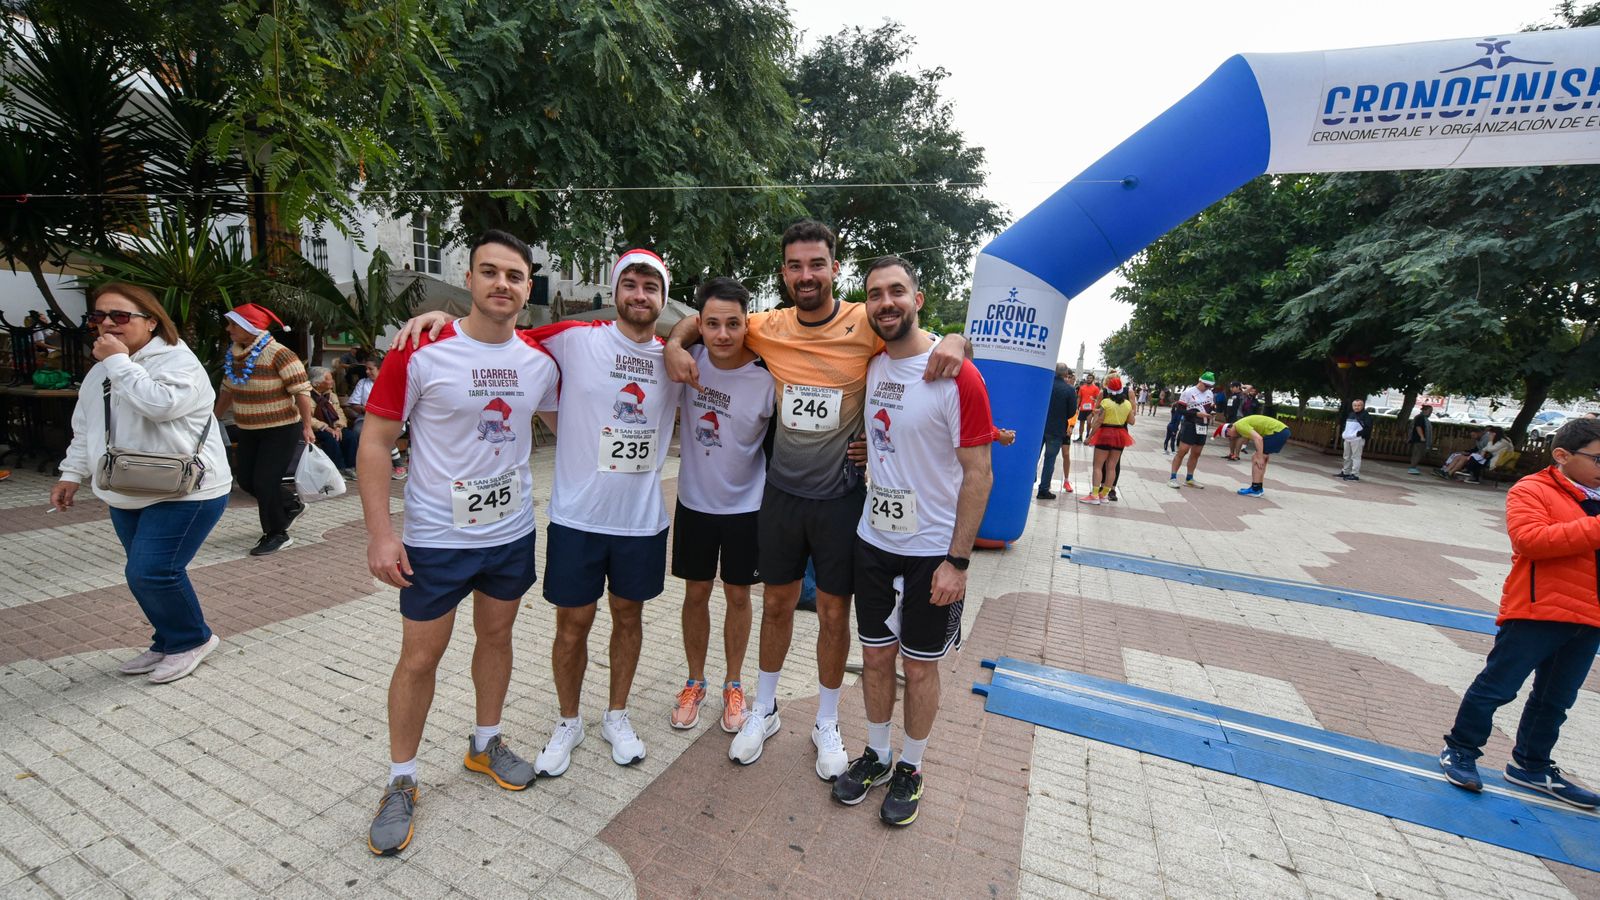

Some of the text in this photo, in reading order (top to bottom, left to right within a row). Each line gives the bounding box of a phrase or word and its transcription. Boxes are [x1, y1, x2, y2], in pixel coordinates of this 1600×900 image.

[1312, 125, 1424, 142] CRONOMETRAJE
[1428, 125, 1439, 136] Y
[1440, 117, 1558, 136] ORGANIZACIÓN
[1558, 116, 1584, 129] DE
[986, 304, 1037, 324] CRONO
[969, 320, 1049, 350] FINISHER
[616, 354, 653, 368] II CARRERA
[472, 369, 518, 379] II CARRERA
[628, 366, 654, 376] SILVESTRE
[704, 387, 731, 404] CARRERA
[880, 382, 904, 393] CARRERA
[792, 398, 828, 419] 246
[611, 441, 649, 459] 235
[489, 471, 516, 483] SILVESTRE
[468, 486, 511, 512] 245
[873, 497, 903, 519] 243
